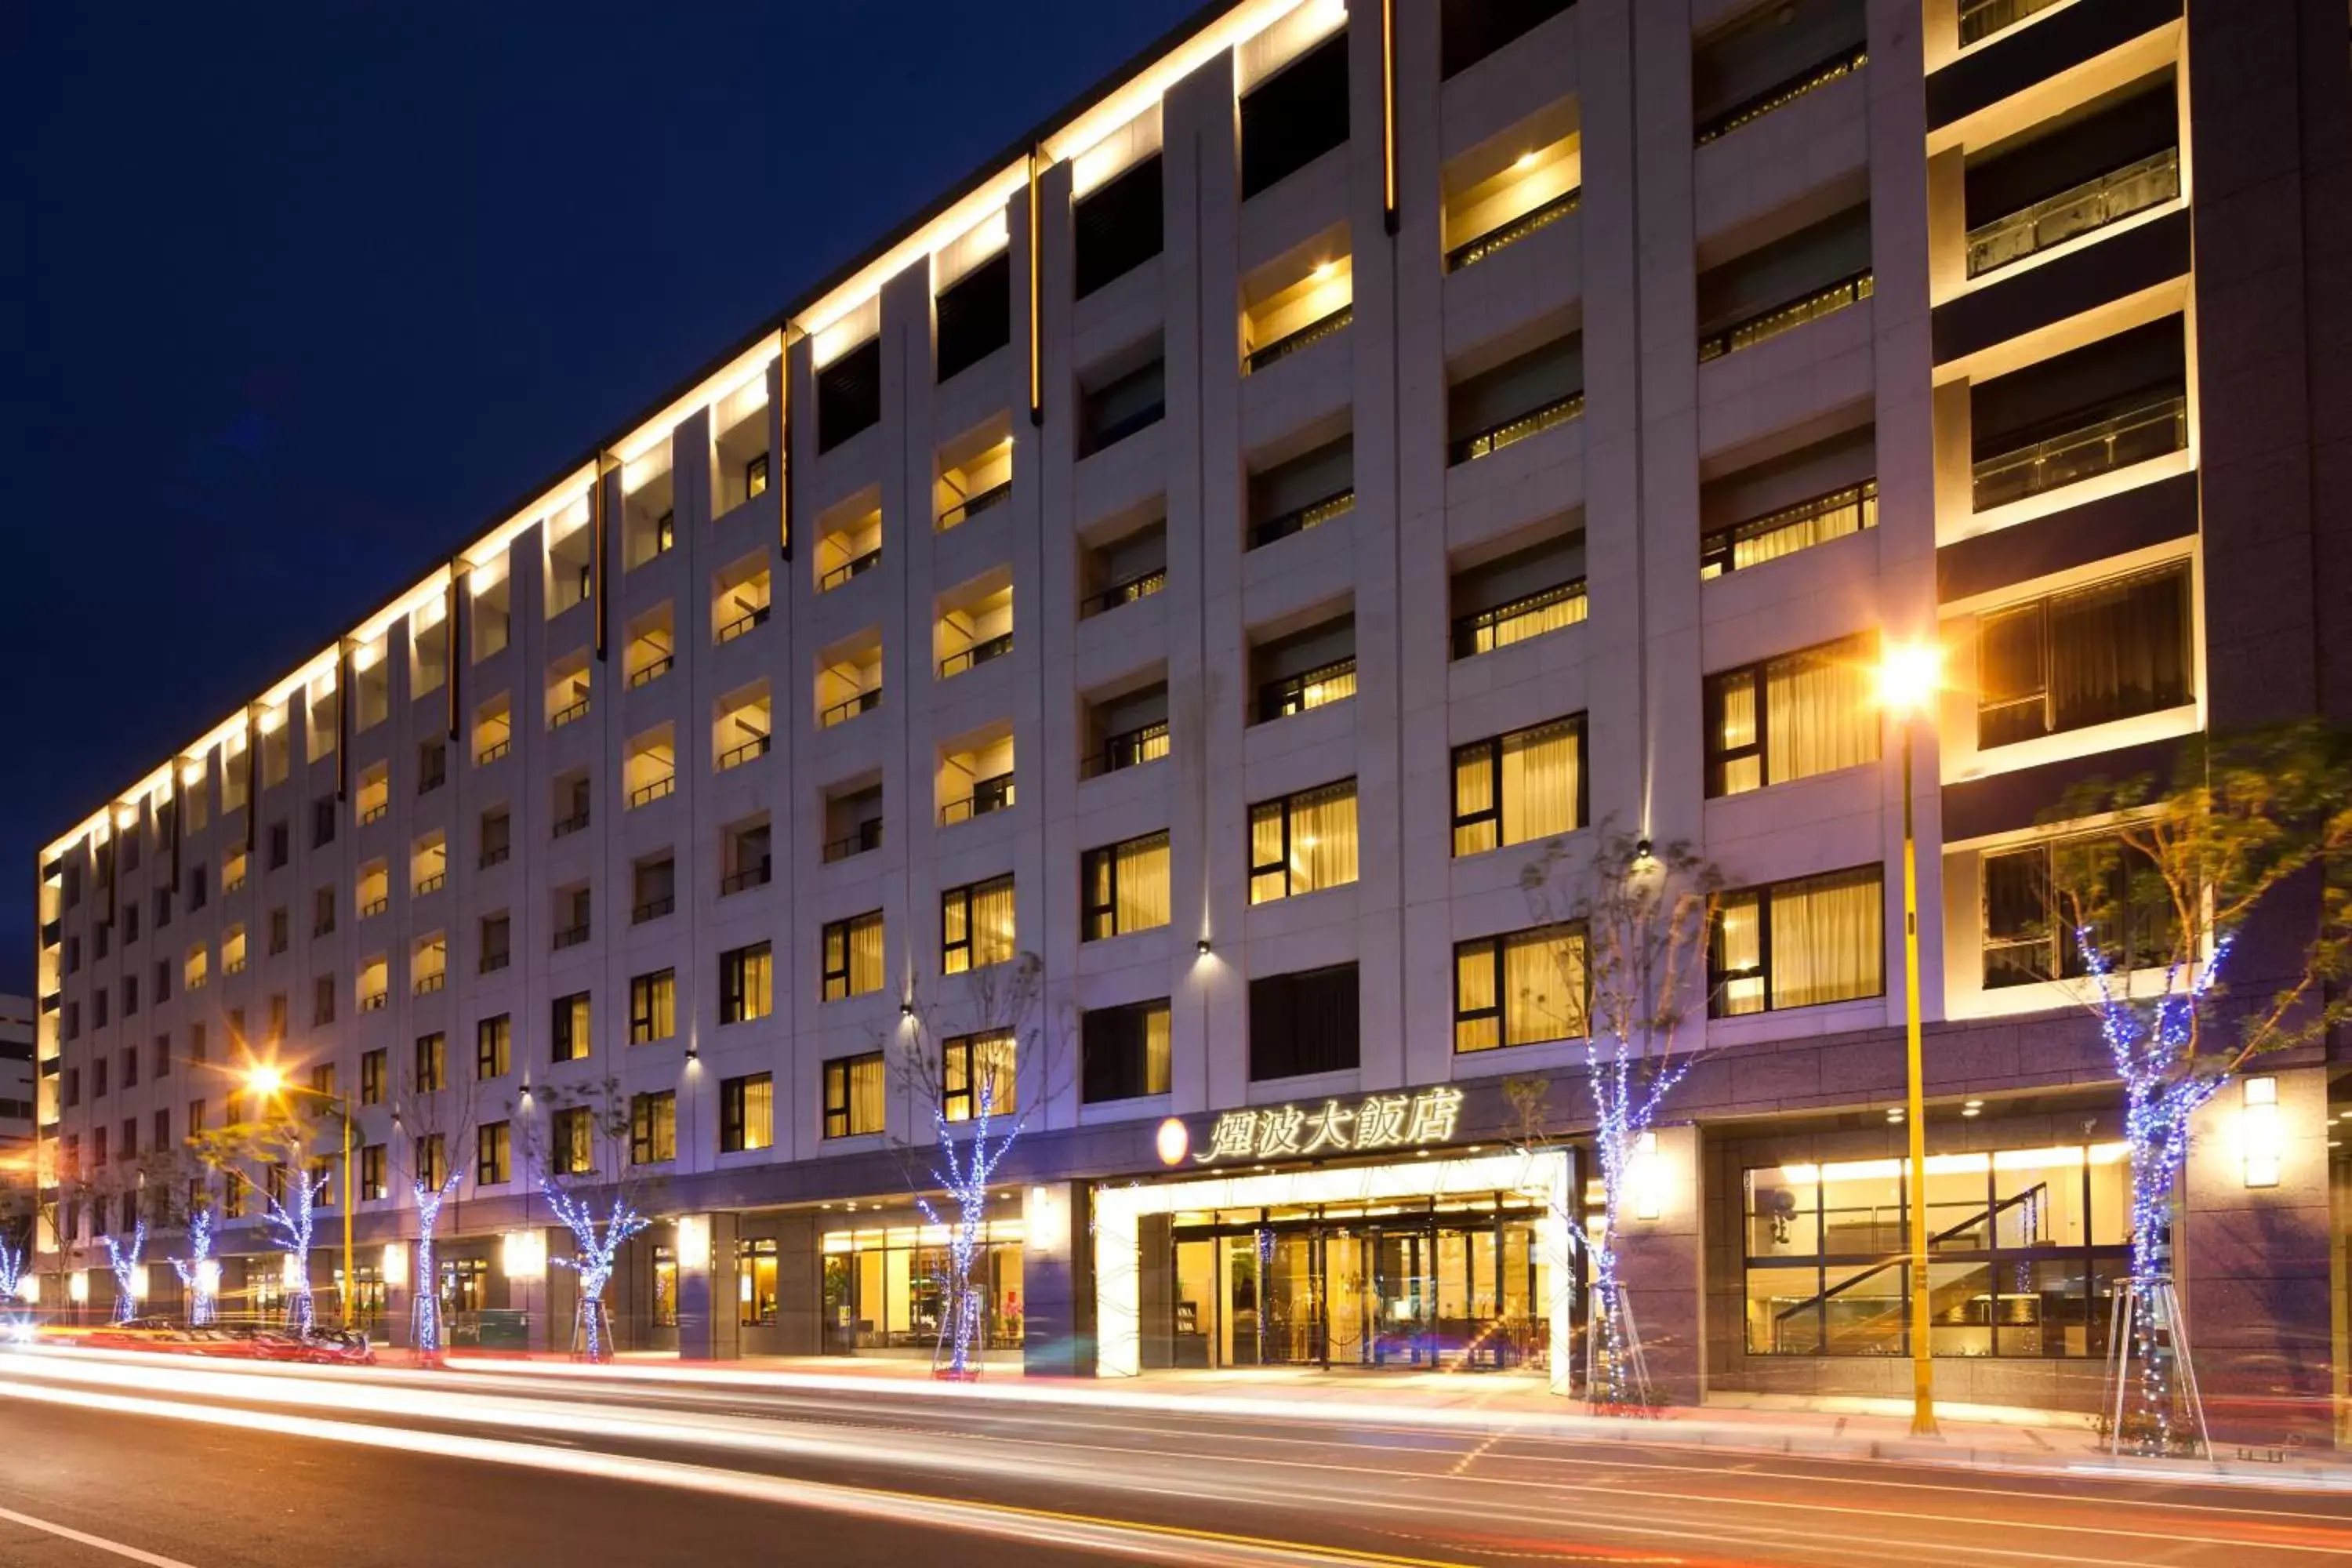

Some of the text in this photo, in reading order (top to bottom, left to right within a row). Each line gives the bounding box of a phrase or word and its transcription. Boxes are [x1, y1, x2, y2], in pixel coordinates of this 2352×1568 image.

[1192, 1087, 1464, 1163] 煙波大飯店
